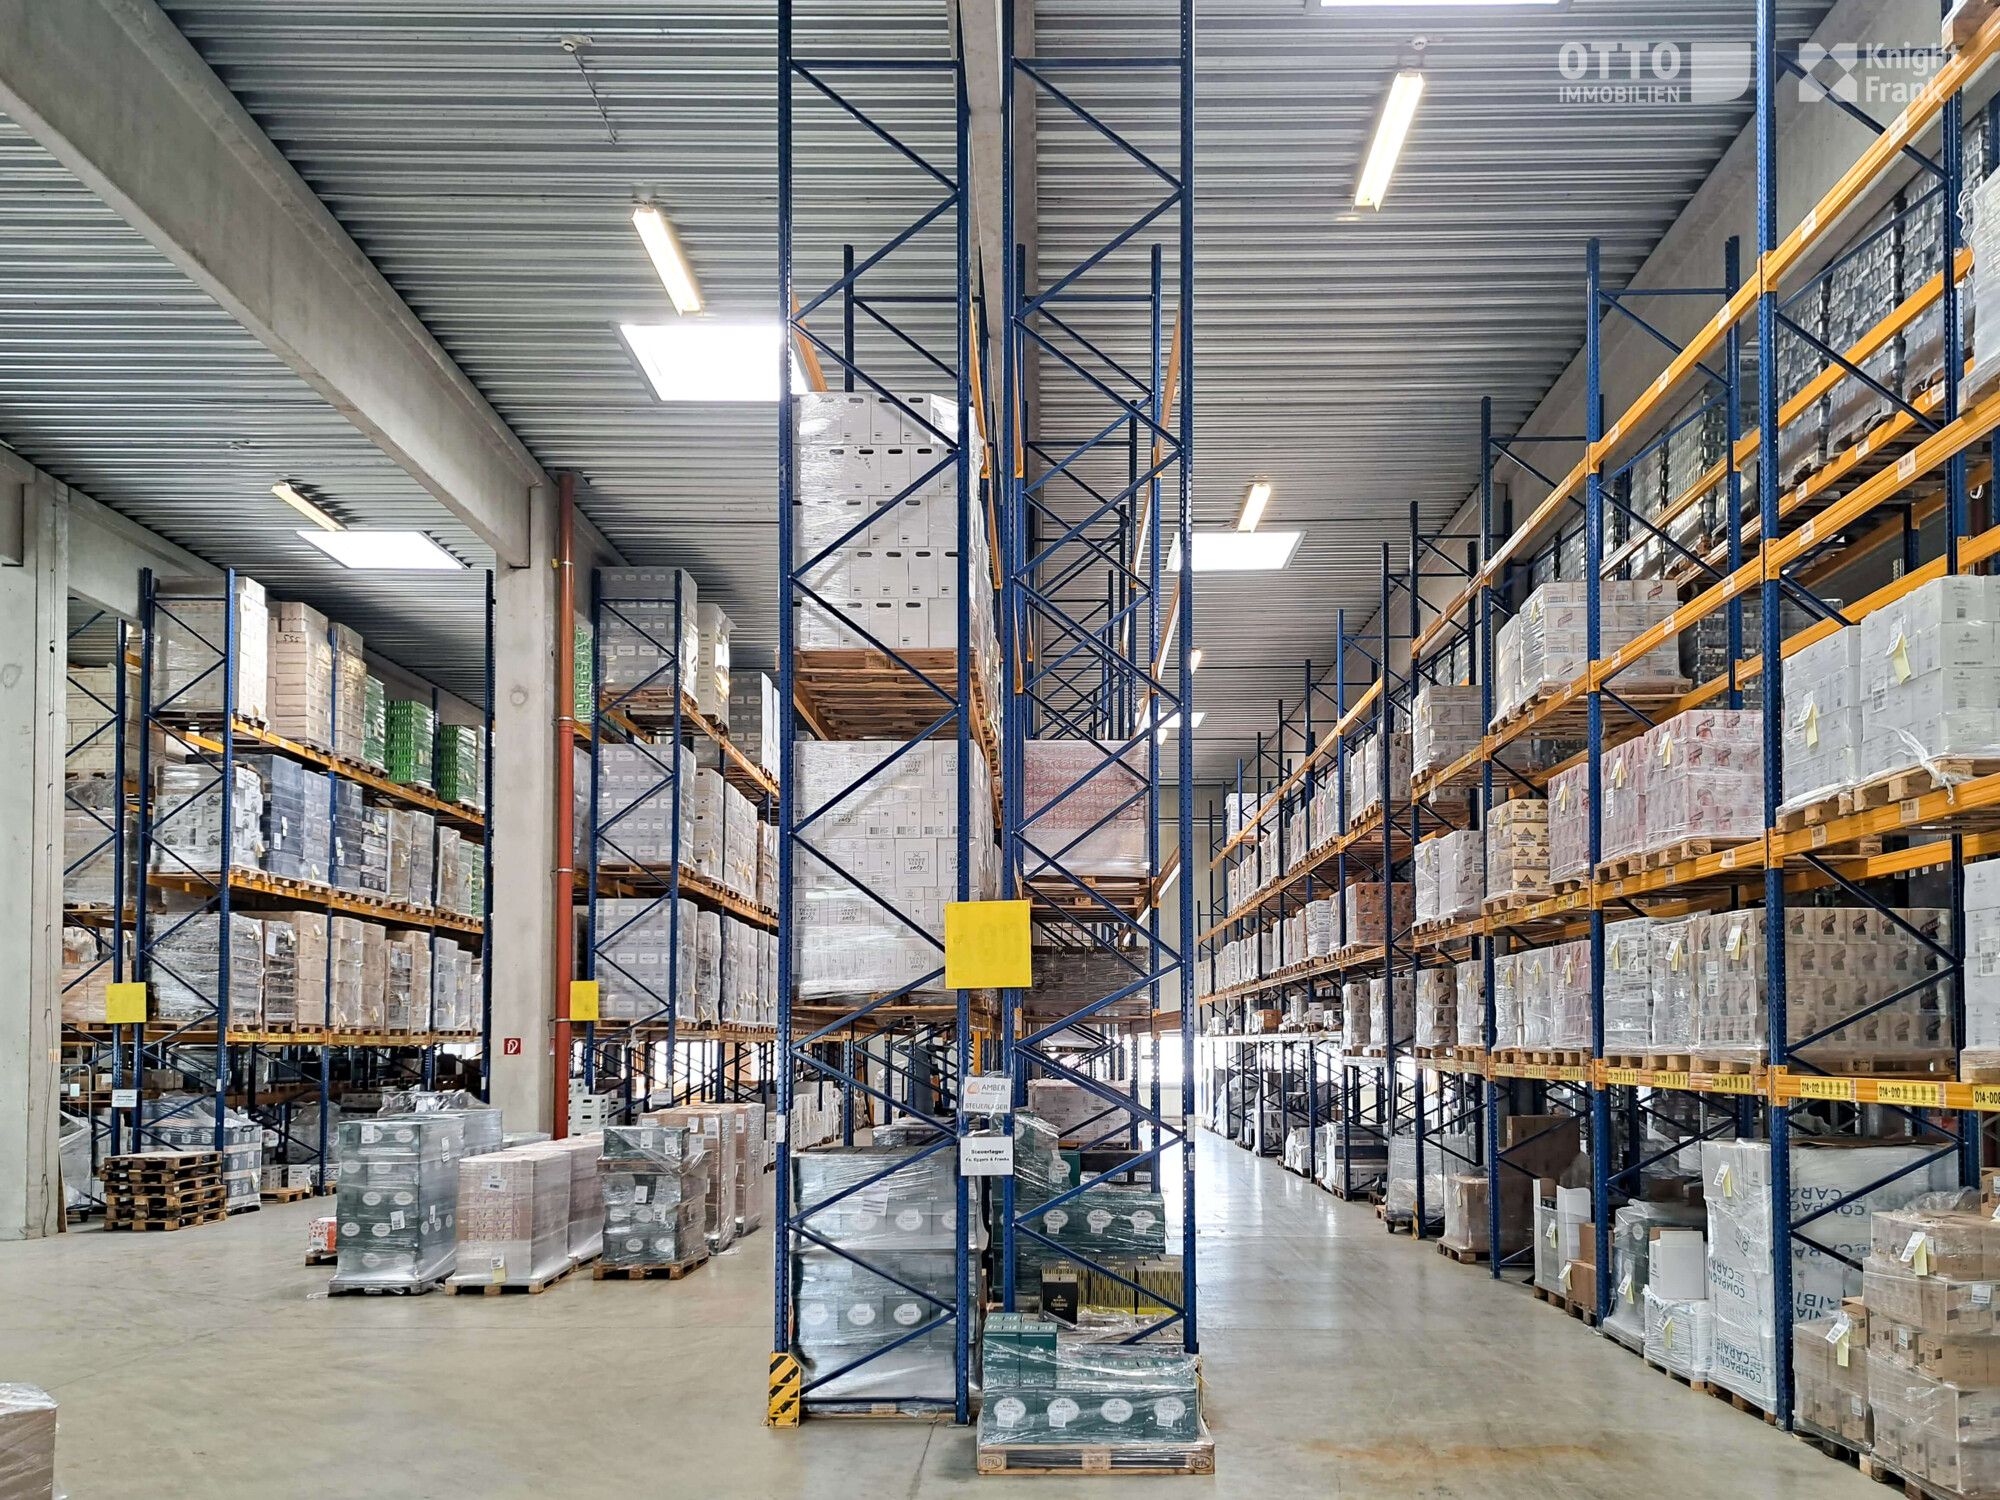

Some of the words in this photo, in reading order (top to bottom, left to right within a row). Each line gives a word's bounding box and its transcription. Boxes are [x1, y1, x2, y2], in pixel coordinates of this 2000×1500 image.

[981, 1083, 1006, 1091] AMBER
[1801, 1082, 1820, 1093] 014-012
[1878, 1085, 1900, 1098] 014-010
